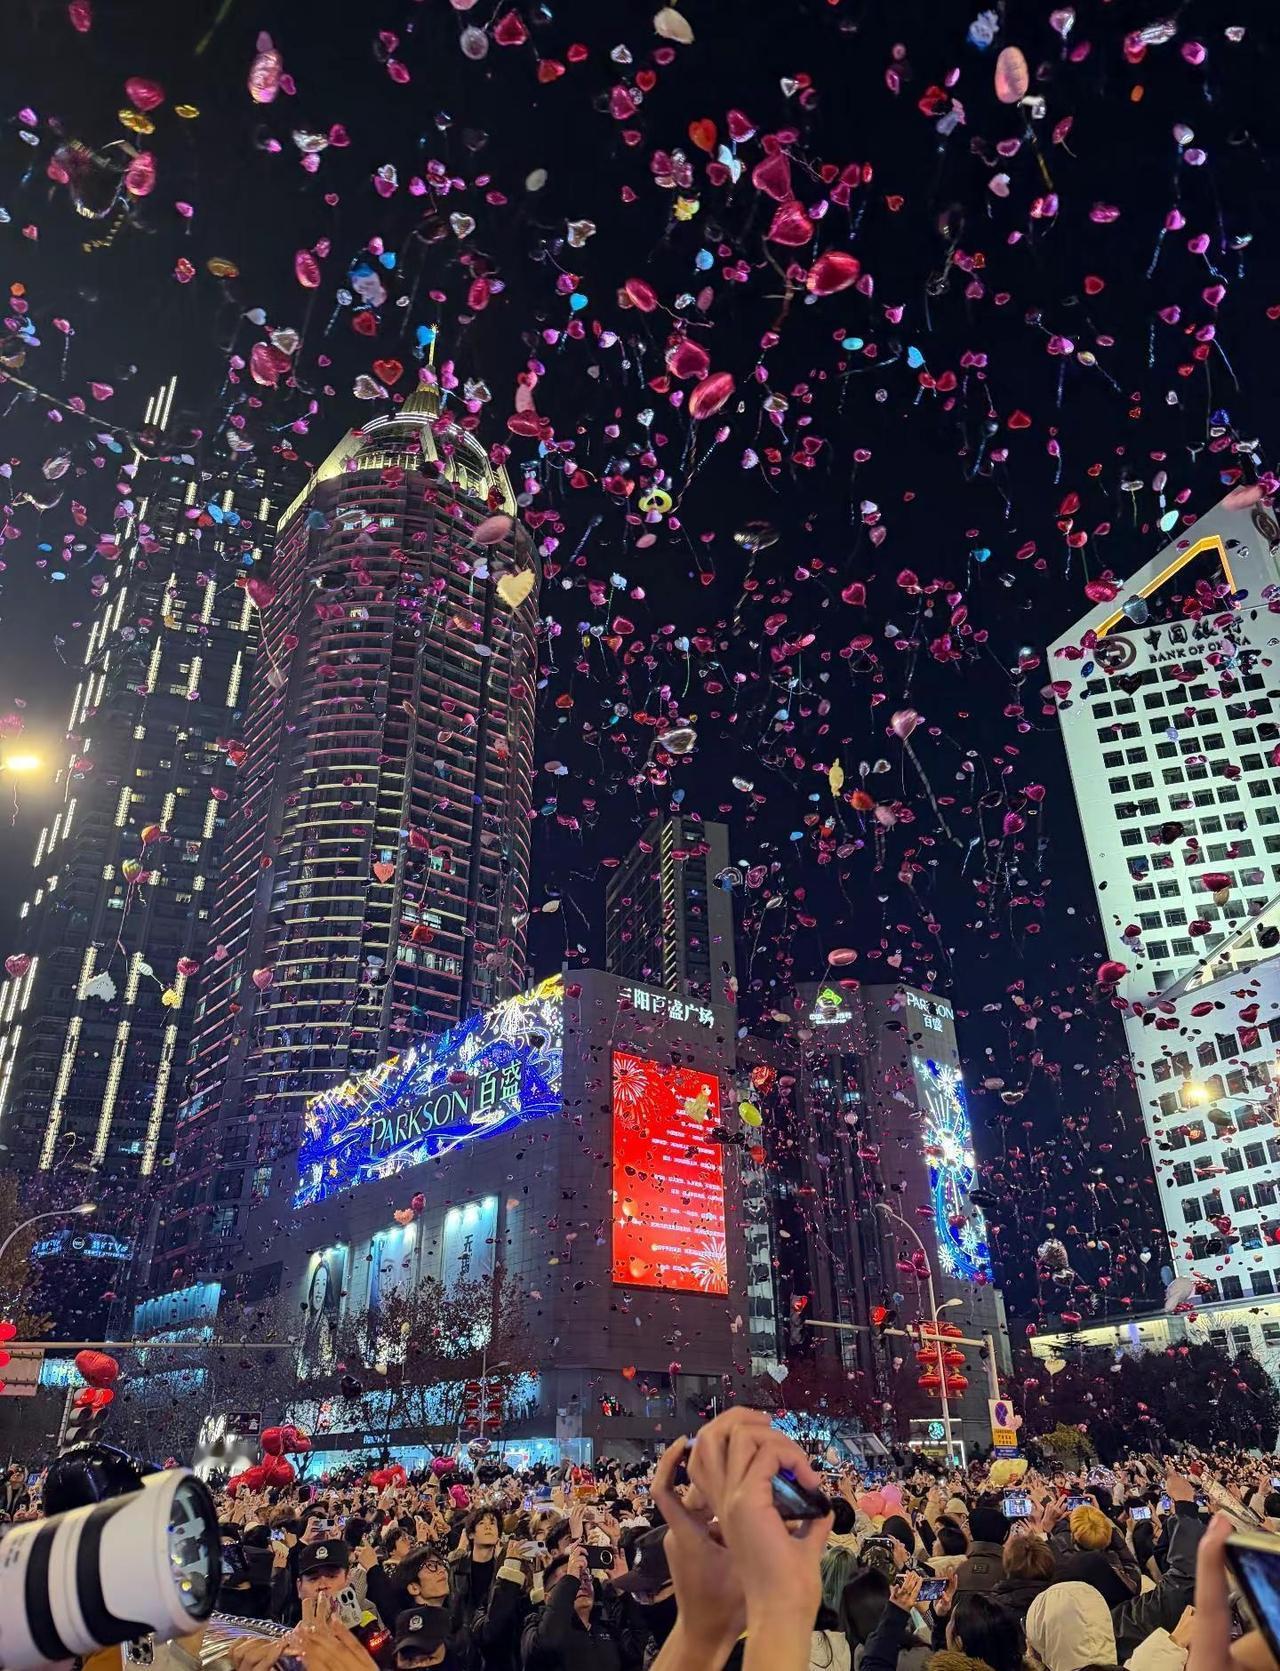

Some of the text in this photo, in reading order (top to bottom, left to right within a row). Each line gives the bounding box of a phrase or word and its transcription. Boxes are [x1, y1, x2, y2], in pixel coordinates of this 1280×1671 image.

[1149, 648, 1187, 664] BANK
[1188, 645, 1206, 656] OF
[922, 1013, 944, 1033] 百盛
[369, 1058, 522, 1157] PARKSON 百盛
